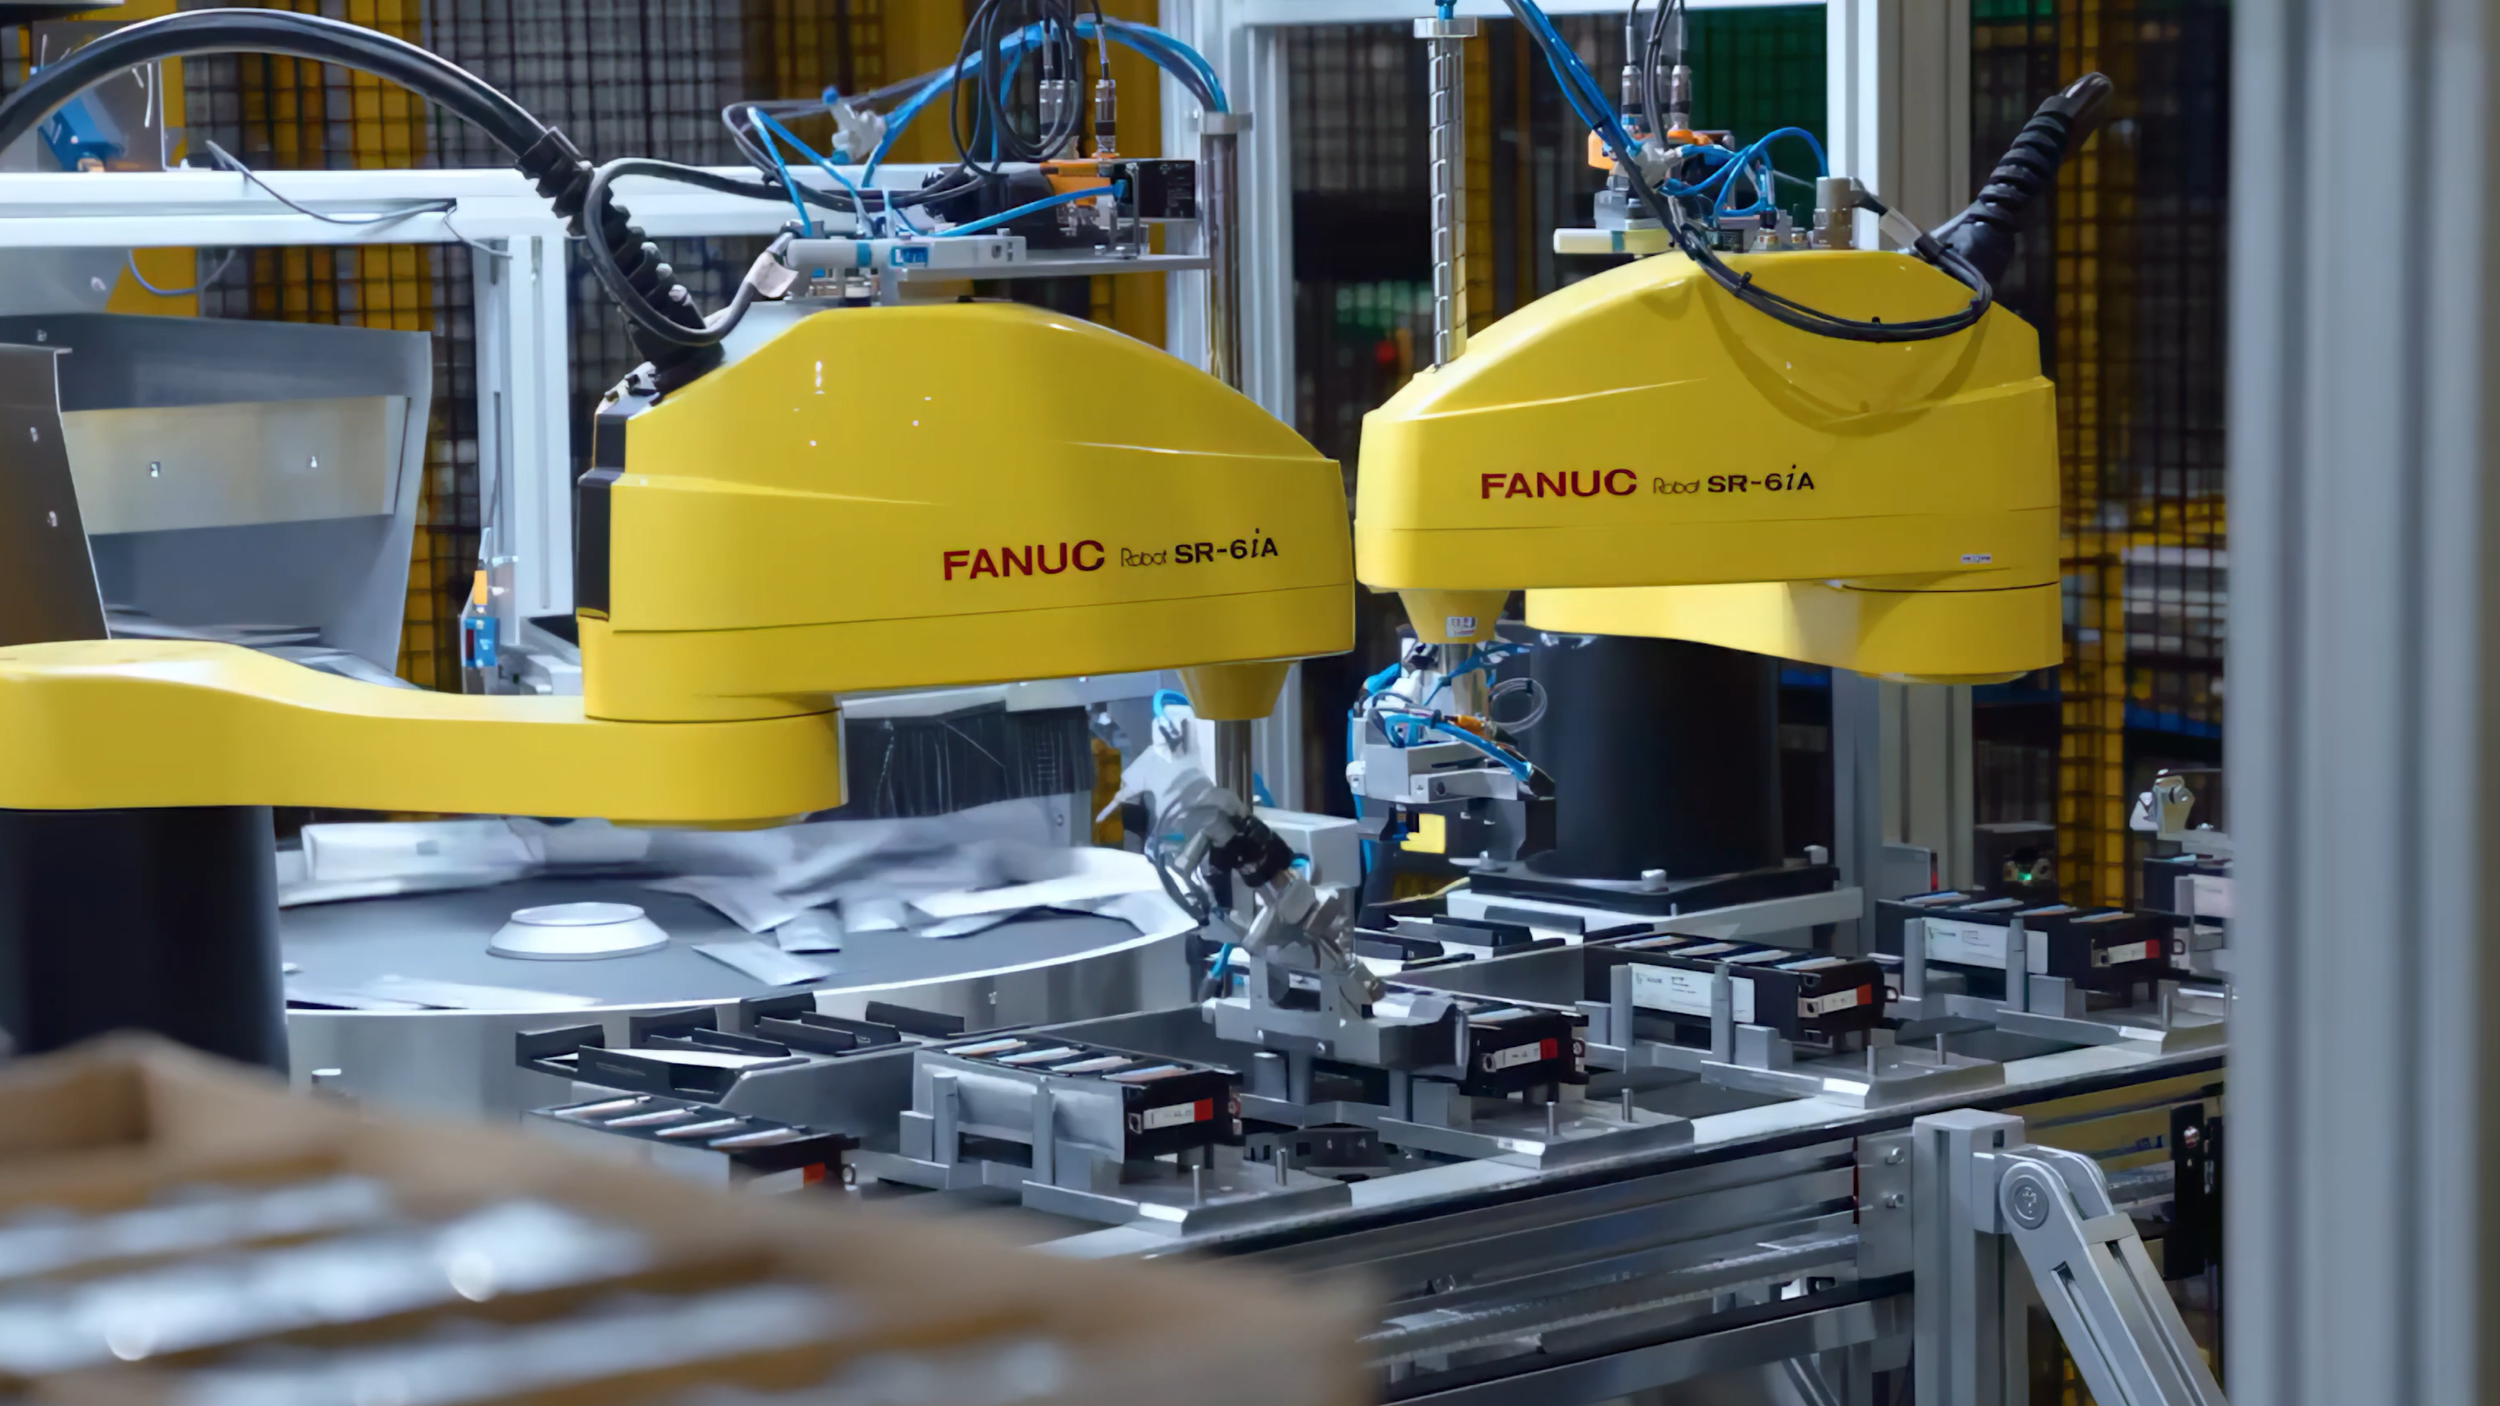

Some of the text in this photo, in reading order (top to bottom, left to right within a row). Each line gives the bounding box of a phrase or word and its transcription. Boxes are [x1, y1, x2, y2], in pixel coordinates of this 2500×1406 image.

[1481, 468, 1637, 499] FANUC
[1707, 464, 1815, 493] SR-6iA
[943, 539, 1105, 581] FANUC
[1174, 528, 1279, 565] SR-6iA
